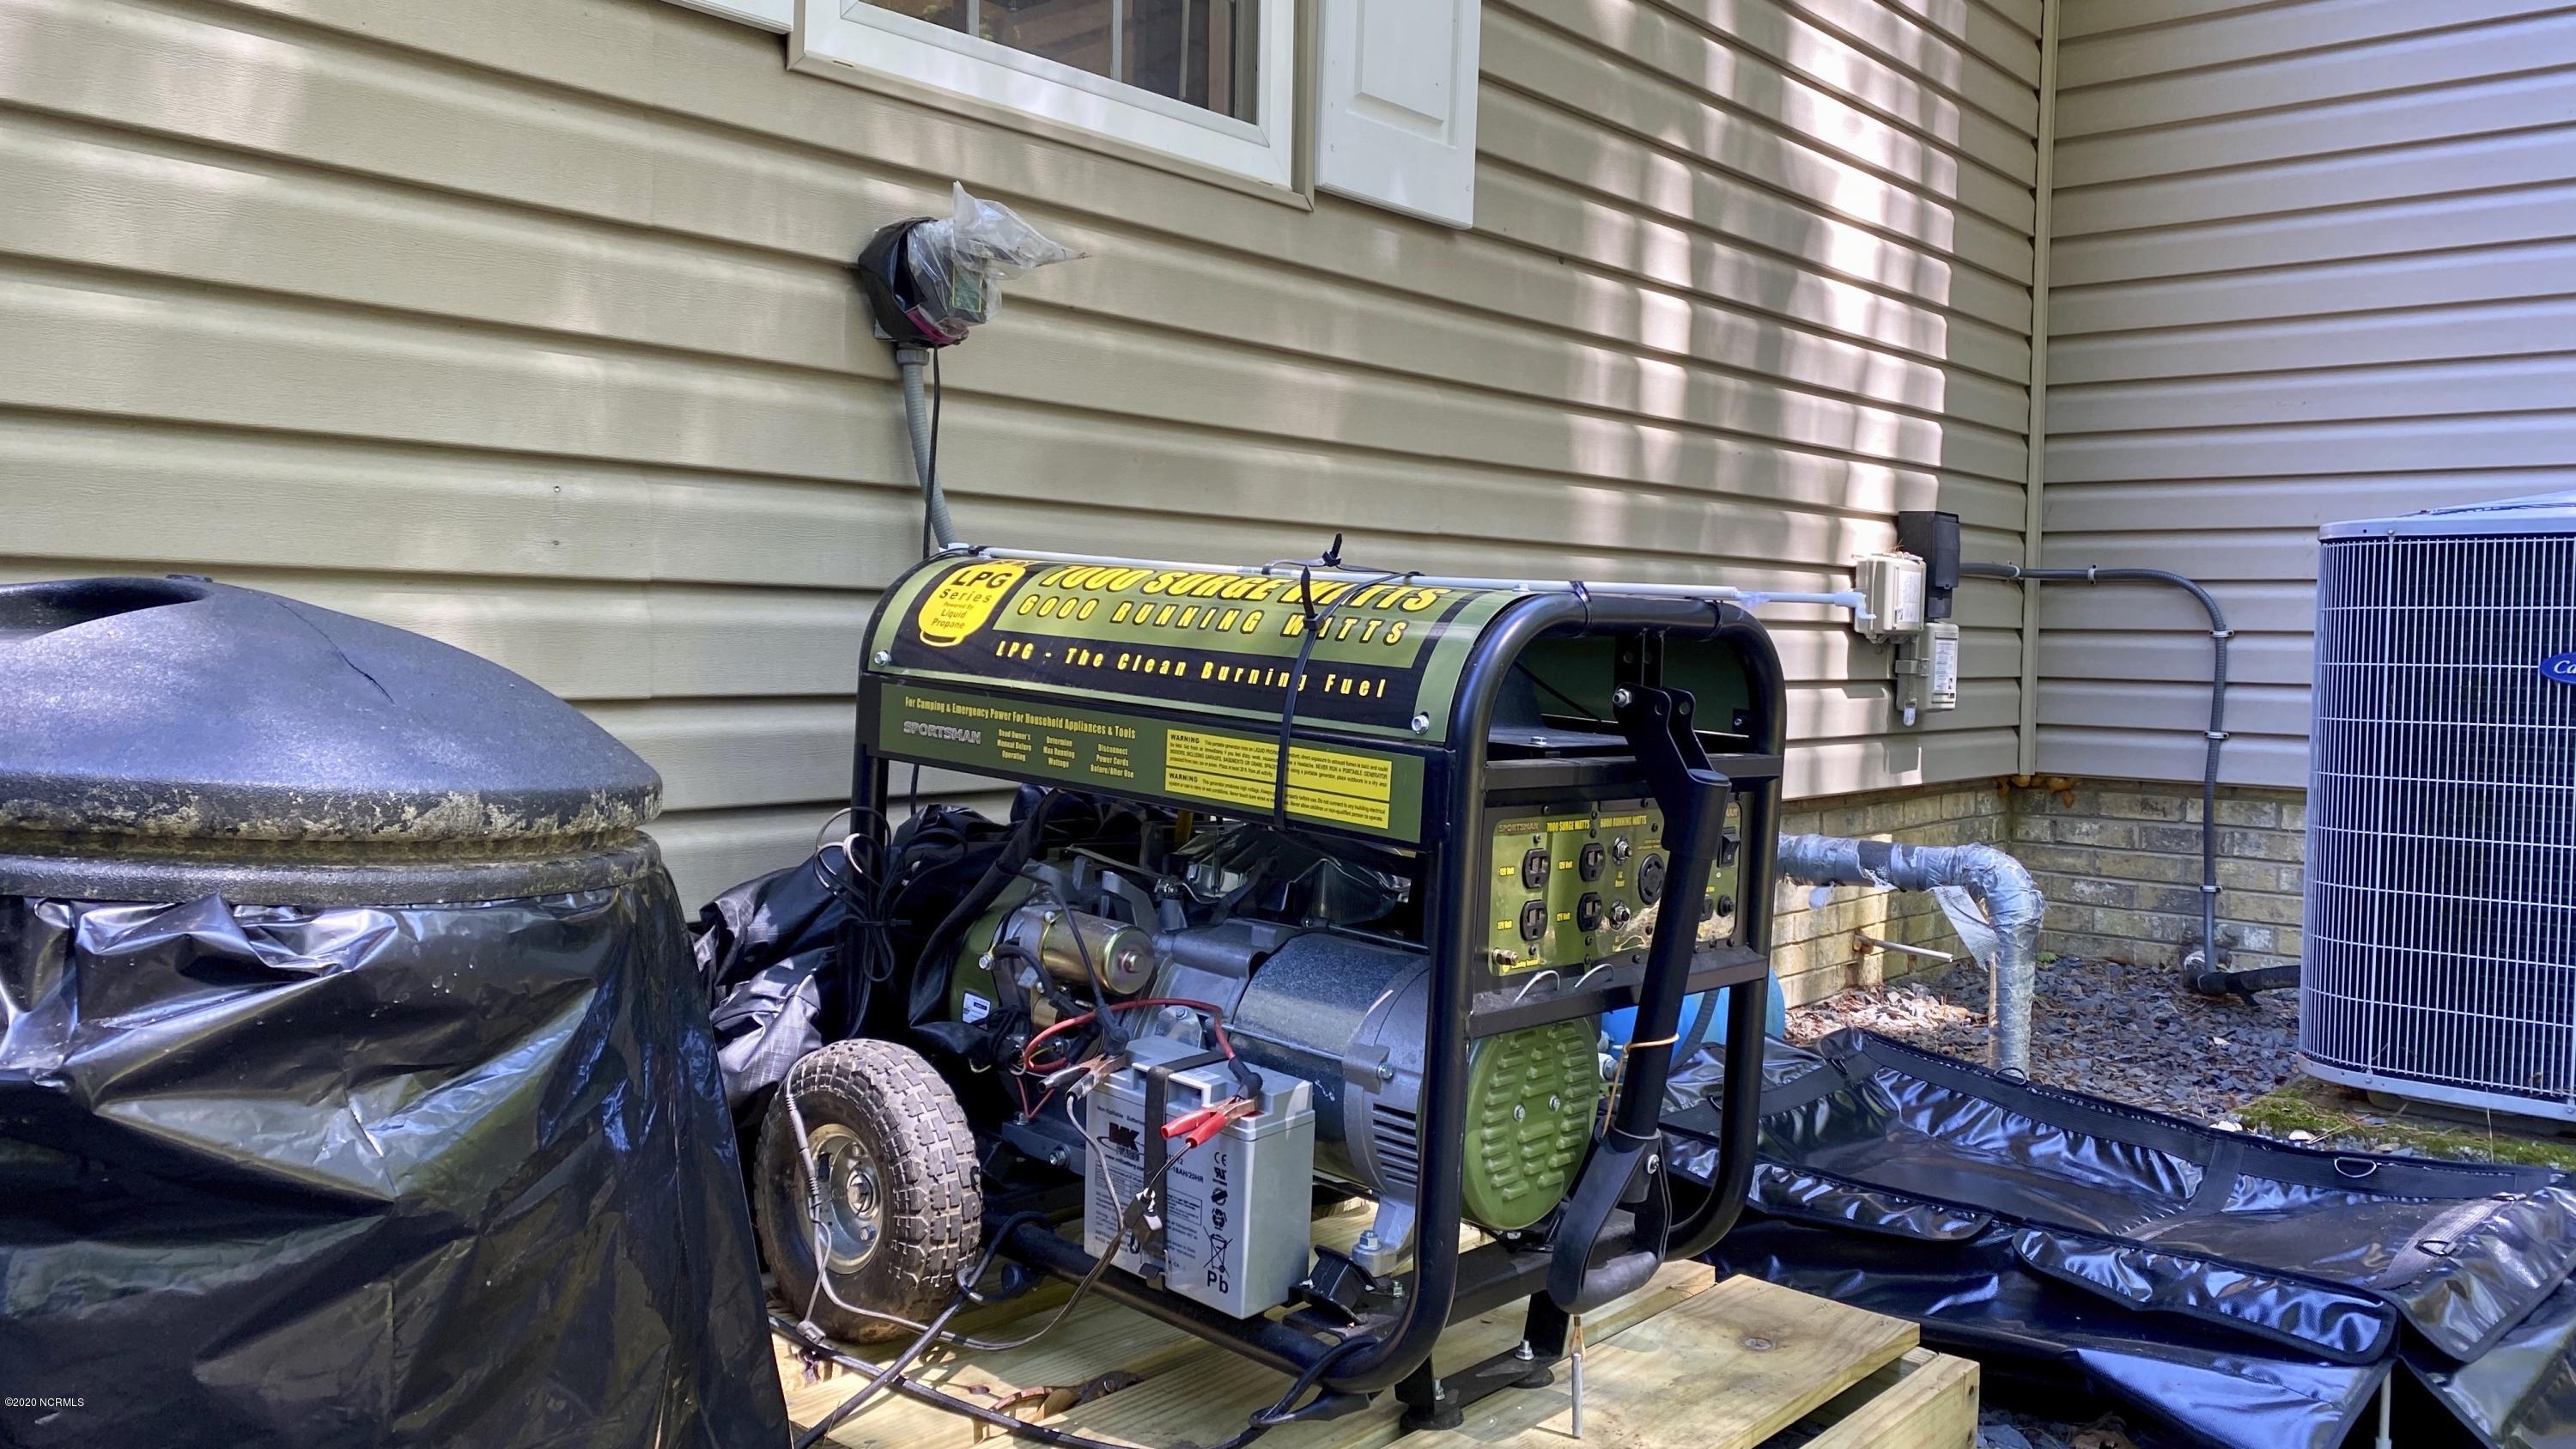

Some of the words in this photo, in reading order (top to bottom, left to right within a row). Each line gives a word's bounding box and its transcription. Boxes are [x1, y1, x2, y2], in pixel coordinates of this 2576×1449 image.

[951, 570, 1012, 588] LPG
[1141, 571, 1292, 600] SURGE
[939, 588, 993, 603] Series
[941, 609, 968, 619] Liquid
[1018, 594, 1099, 621] 6000
[1110, 600, 1265, 634] RUNNING
[932, 618, 965, 630] Propane
[996, 641, 1034, 660] LPG
[1065, 648, 1104, 667] The
[1117, 653, 1187, 677] Clean
[1324, 673, 1387, 697] Fuel
[905, 697, 916, 708] For
[917, 698, 945, 713] Camping
[946, 703, 951, 713] &
[952, 703, 988, 719] Emergency
[990, 708, 1012, 721] Power
[1013, 711, 1024, 723] For
[1025, 713, 1063, 728] Household
[1065, 718, 1106, 734] Appliances
[1108, 726, 1113, 736] &
[1115, 725, 1136, 740] Tools
[903, 721, 981, 745] SPORTSMAN
[1170, 734, 1200, 744] WARNING
[1169, 772, 1199, 782] WARNING
[1498, 822, 1539, 832] SPORTSMAN
[1546, 822, 1558, 832] 7000
[1558, 820, 1574, 831] SURGE
[1574, 819, 1590, 831] WATTS
[1169, 1166, 1204, 1184] -18AH/20HR
[1207, 1269, 1228, 1294] Pb
